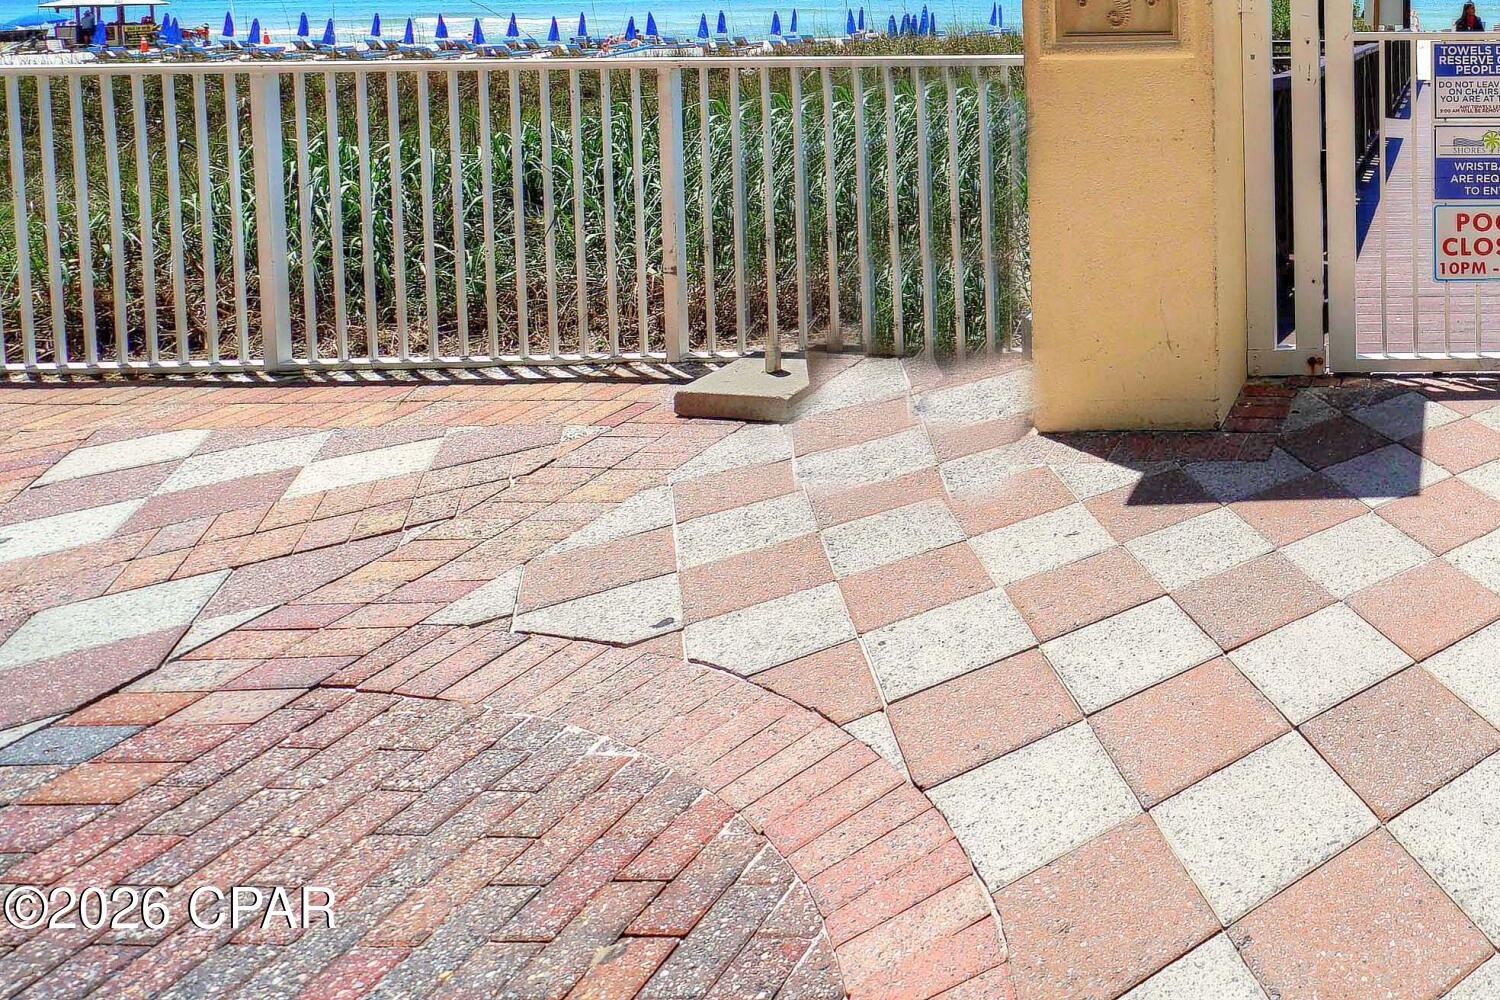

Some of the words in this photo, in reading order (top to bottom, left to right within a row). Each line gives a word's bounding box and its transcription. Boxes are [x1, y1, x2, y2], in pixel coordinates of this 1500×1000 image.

[1440, 46, 1491, 55] TOWELS
[1439, 56, 1493, 64] RESERVE
[1450, 174, 1474, 183] ARE
[1464, 186, 1480, 195] TO
[1440, 262, 1487, 274] 10PM
